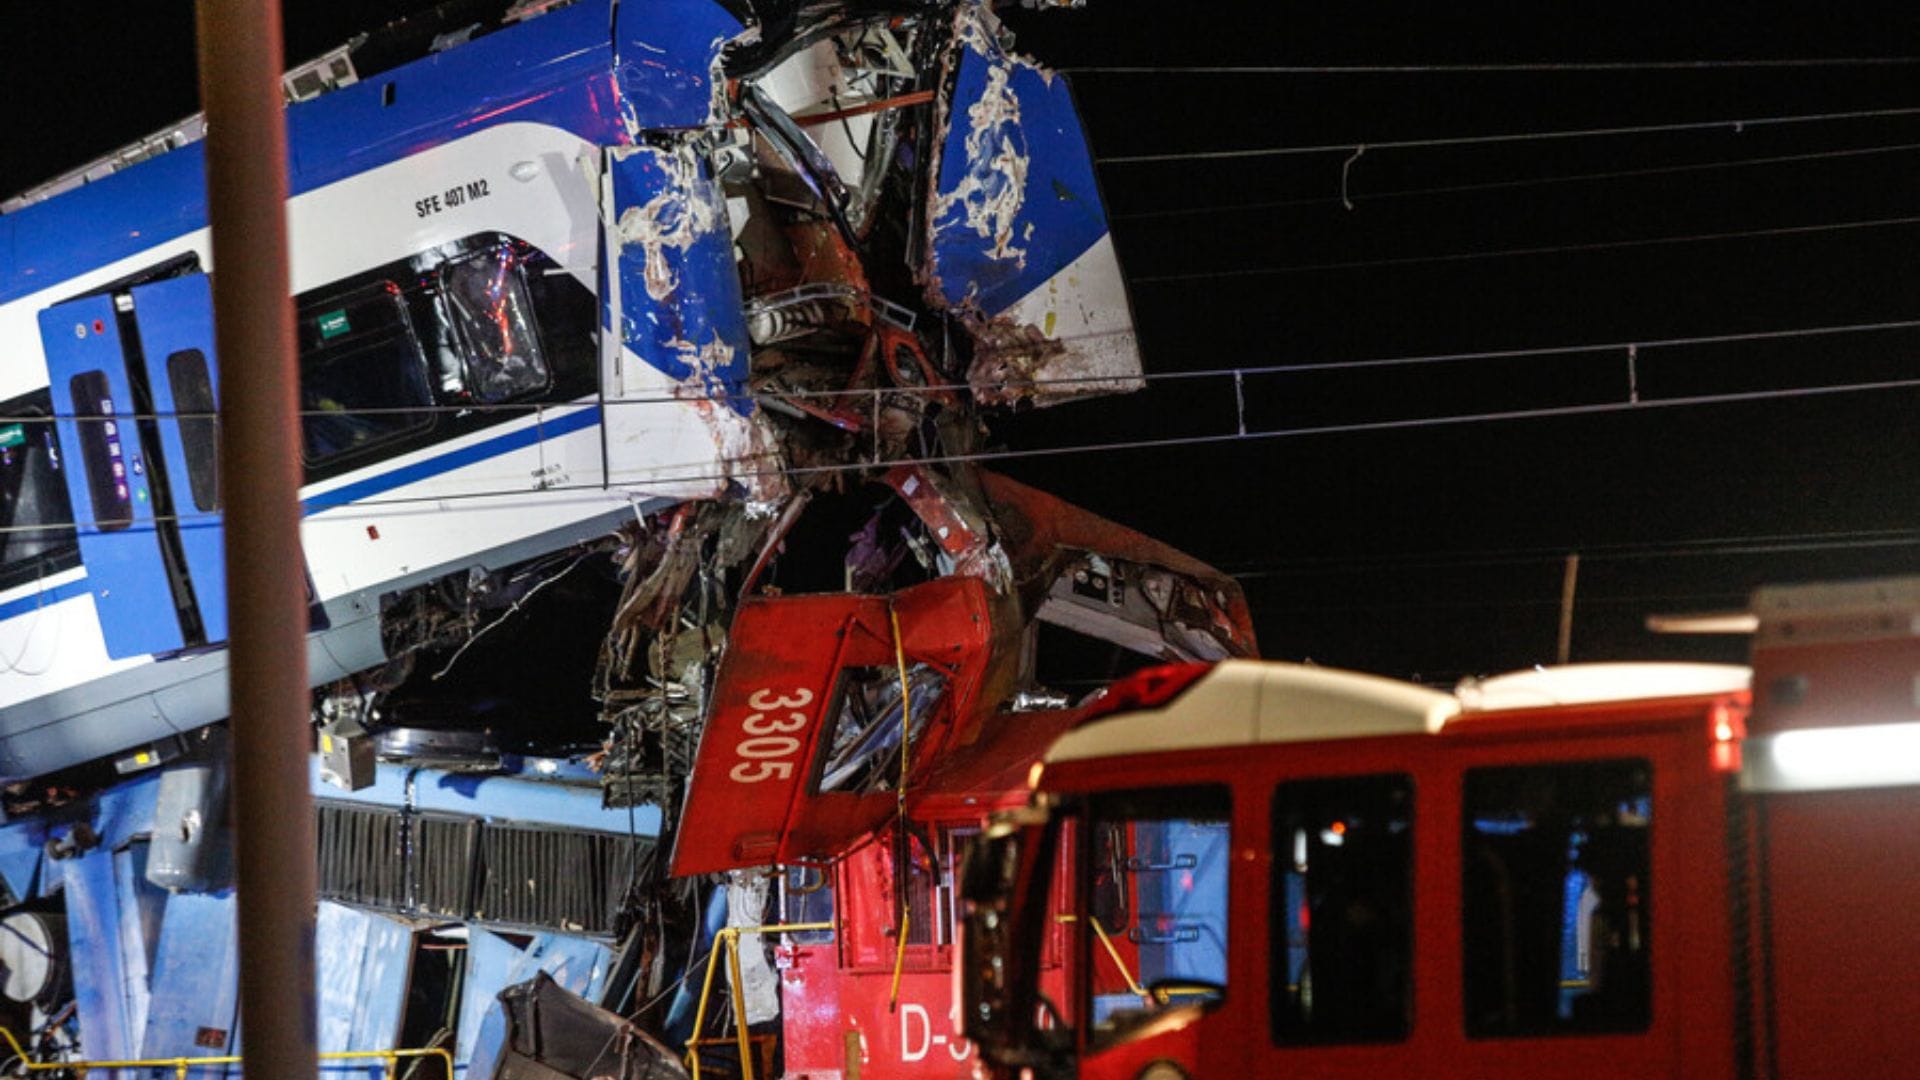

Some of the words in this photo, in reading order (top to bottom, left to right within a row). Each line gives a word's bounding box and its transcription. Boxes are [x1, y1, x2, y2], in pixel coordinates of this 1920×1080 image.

[415, 195, 442, 217] SFE
[467, 179, 490, 200] M2
[729, 688, 813, 783] 3305
